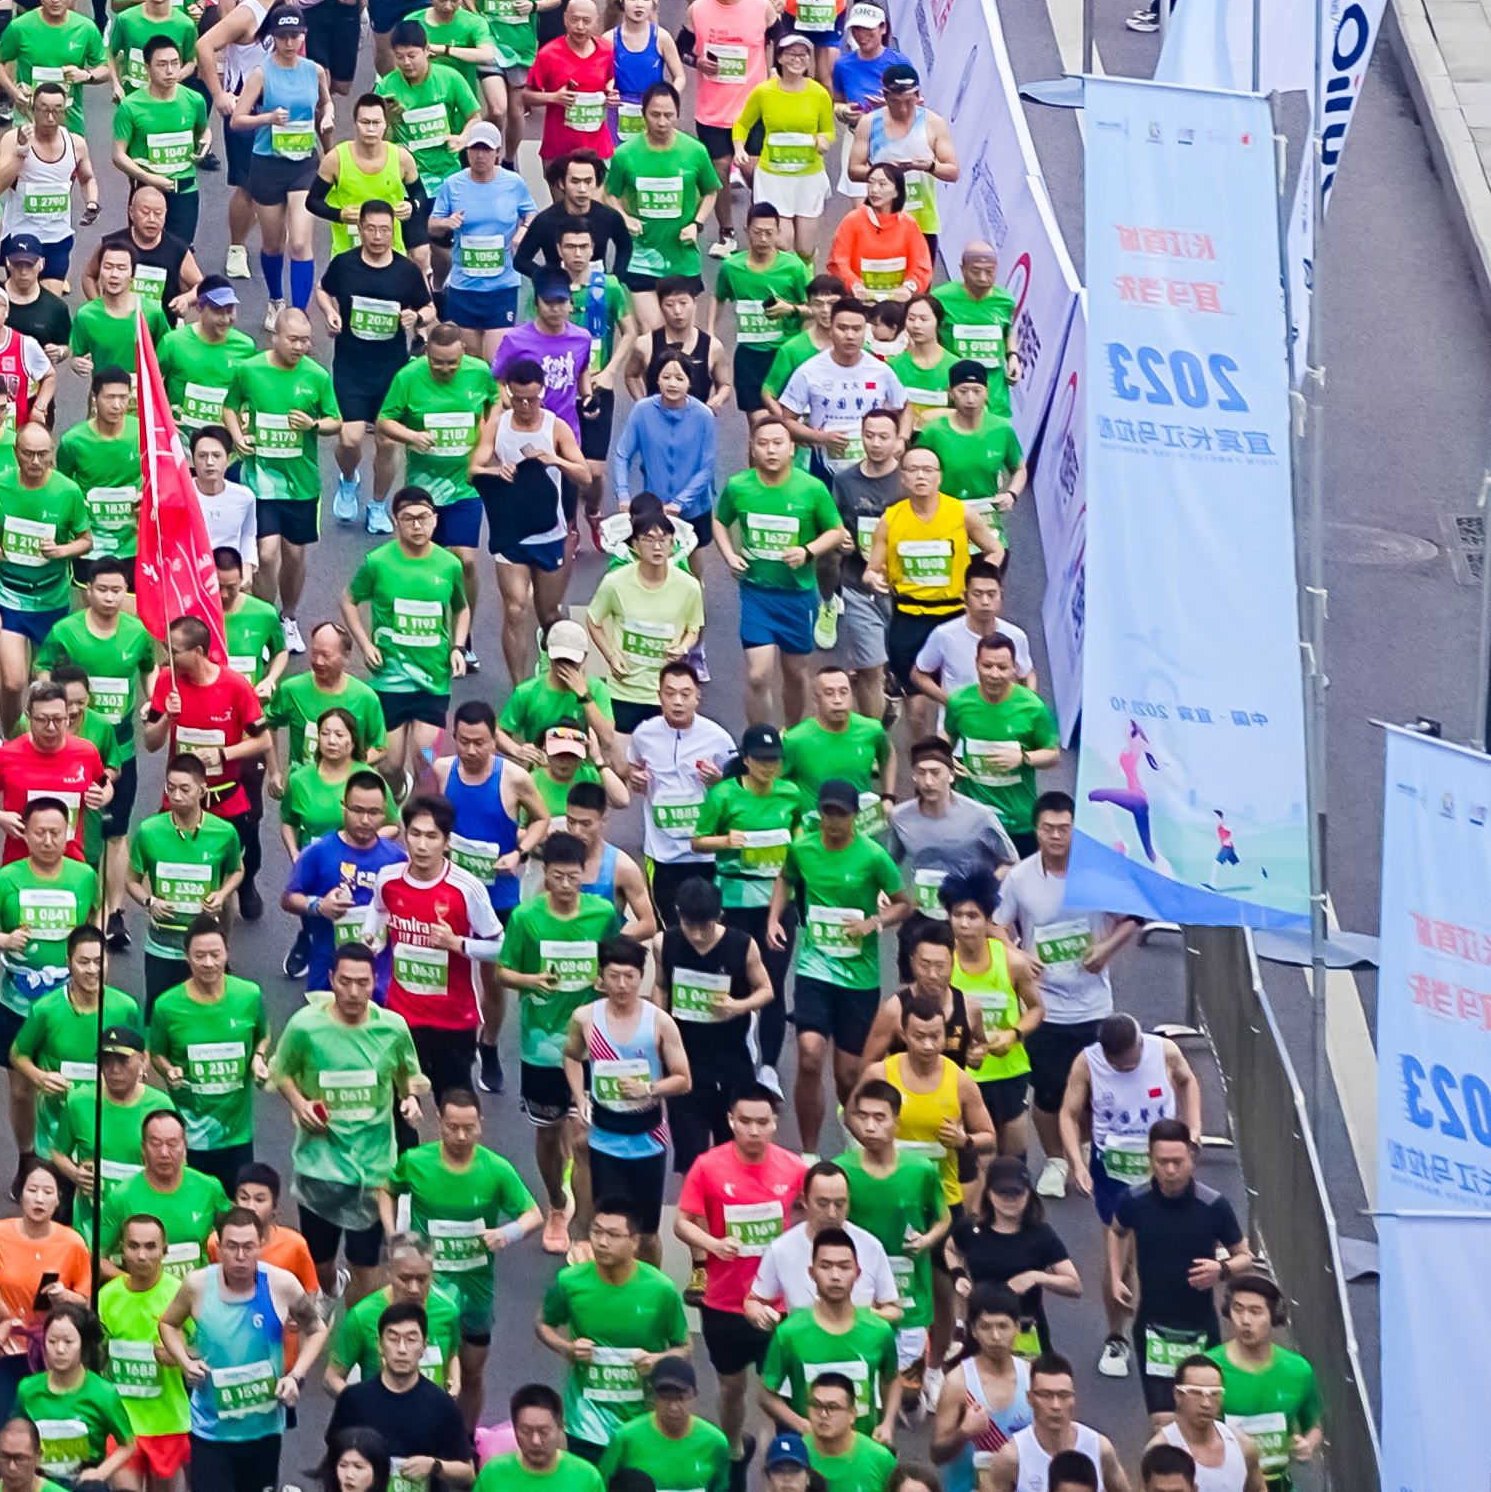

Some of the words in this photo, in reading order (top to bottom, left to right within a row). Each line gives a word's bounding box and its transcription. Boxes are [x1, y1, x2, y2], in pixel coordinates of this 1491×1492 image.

[408, 123, 416, 135] B
[419, 117, 445, 131] 0440
[153, 149, 160, 159] B
[163, 146, 188, 159] 1047
[29, 197, 37, 208] B
[41, 195, 66, 208] 2790
[642, 193, 650, 205] B
[653, 191, 678, 204] 2661
[464, 251, 472, 261] B
[474, 251, 501, 264] 1056
[133, 279, 160, 292] 1866
[356, 313, 364, 324] B
[367, 313, 393, 325] 2074
[260, 431, 268, 442] B
[271, 430, 297, 443] 2170
[443, 428, 469, 442] 2187
[92, 502, 101, 515] B
[398, 616, 407, 628] B
[410, 615, 437, 630] 1193
[25, 908, 35, 921] B
[39, 907, 71, 922] 0841
